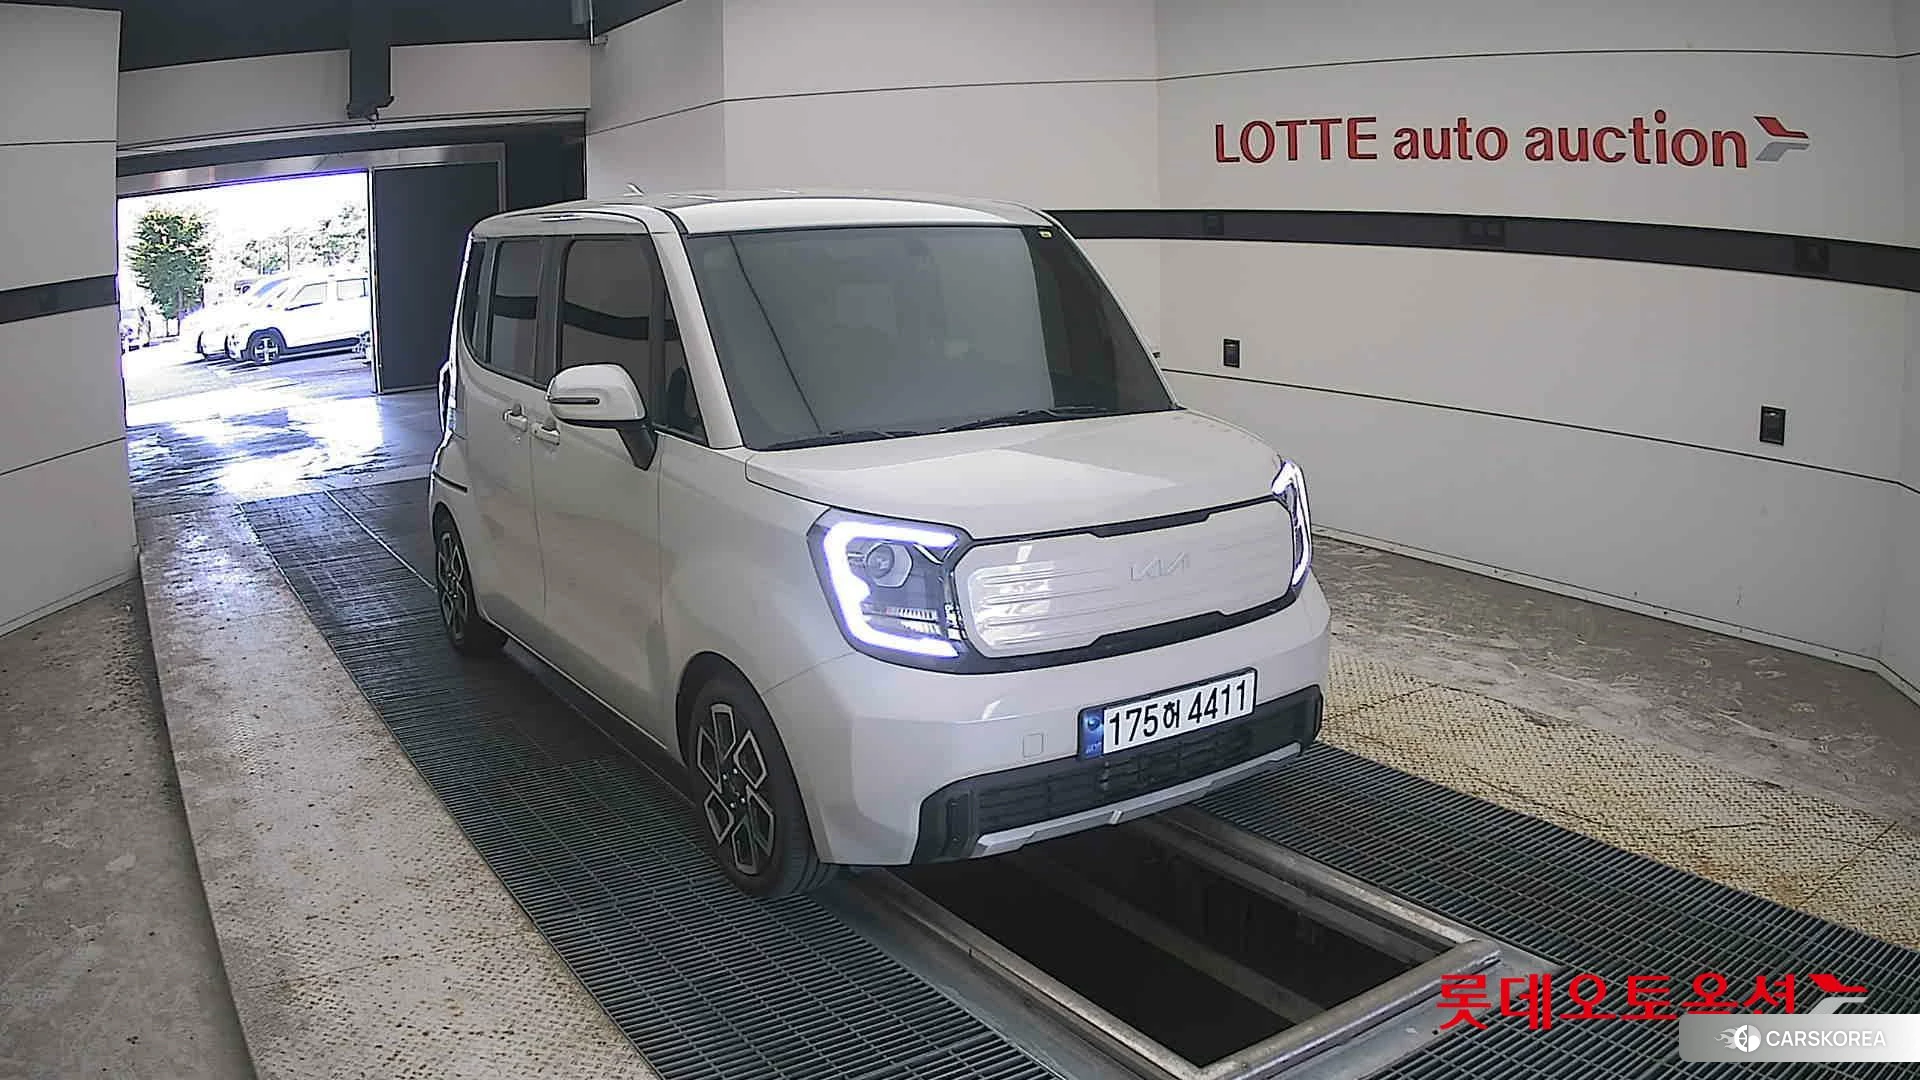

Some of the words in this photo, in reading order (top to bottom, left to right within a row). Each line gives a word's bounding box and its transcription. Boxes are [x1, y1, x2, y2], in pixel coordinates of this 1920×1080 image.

[1215, 117, 1378, 163] LOTTE
[1393, 117, 1509, 162] auto
[1525, 110, 1748, 168] auction
[1109, 699, 1181, 745] 175허
[1188, 680, 1246, 724] 4411
